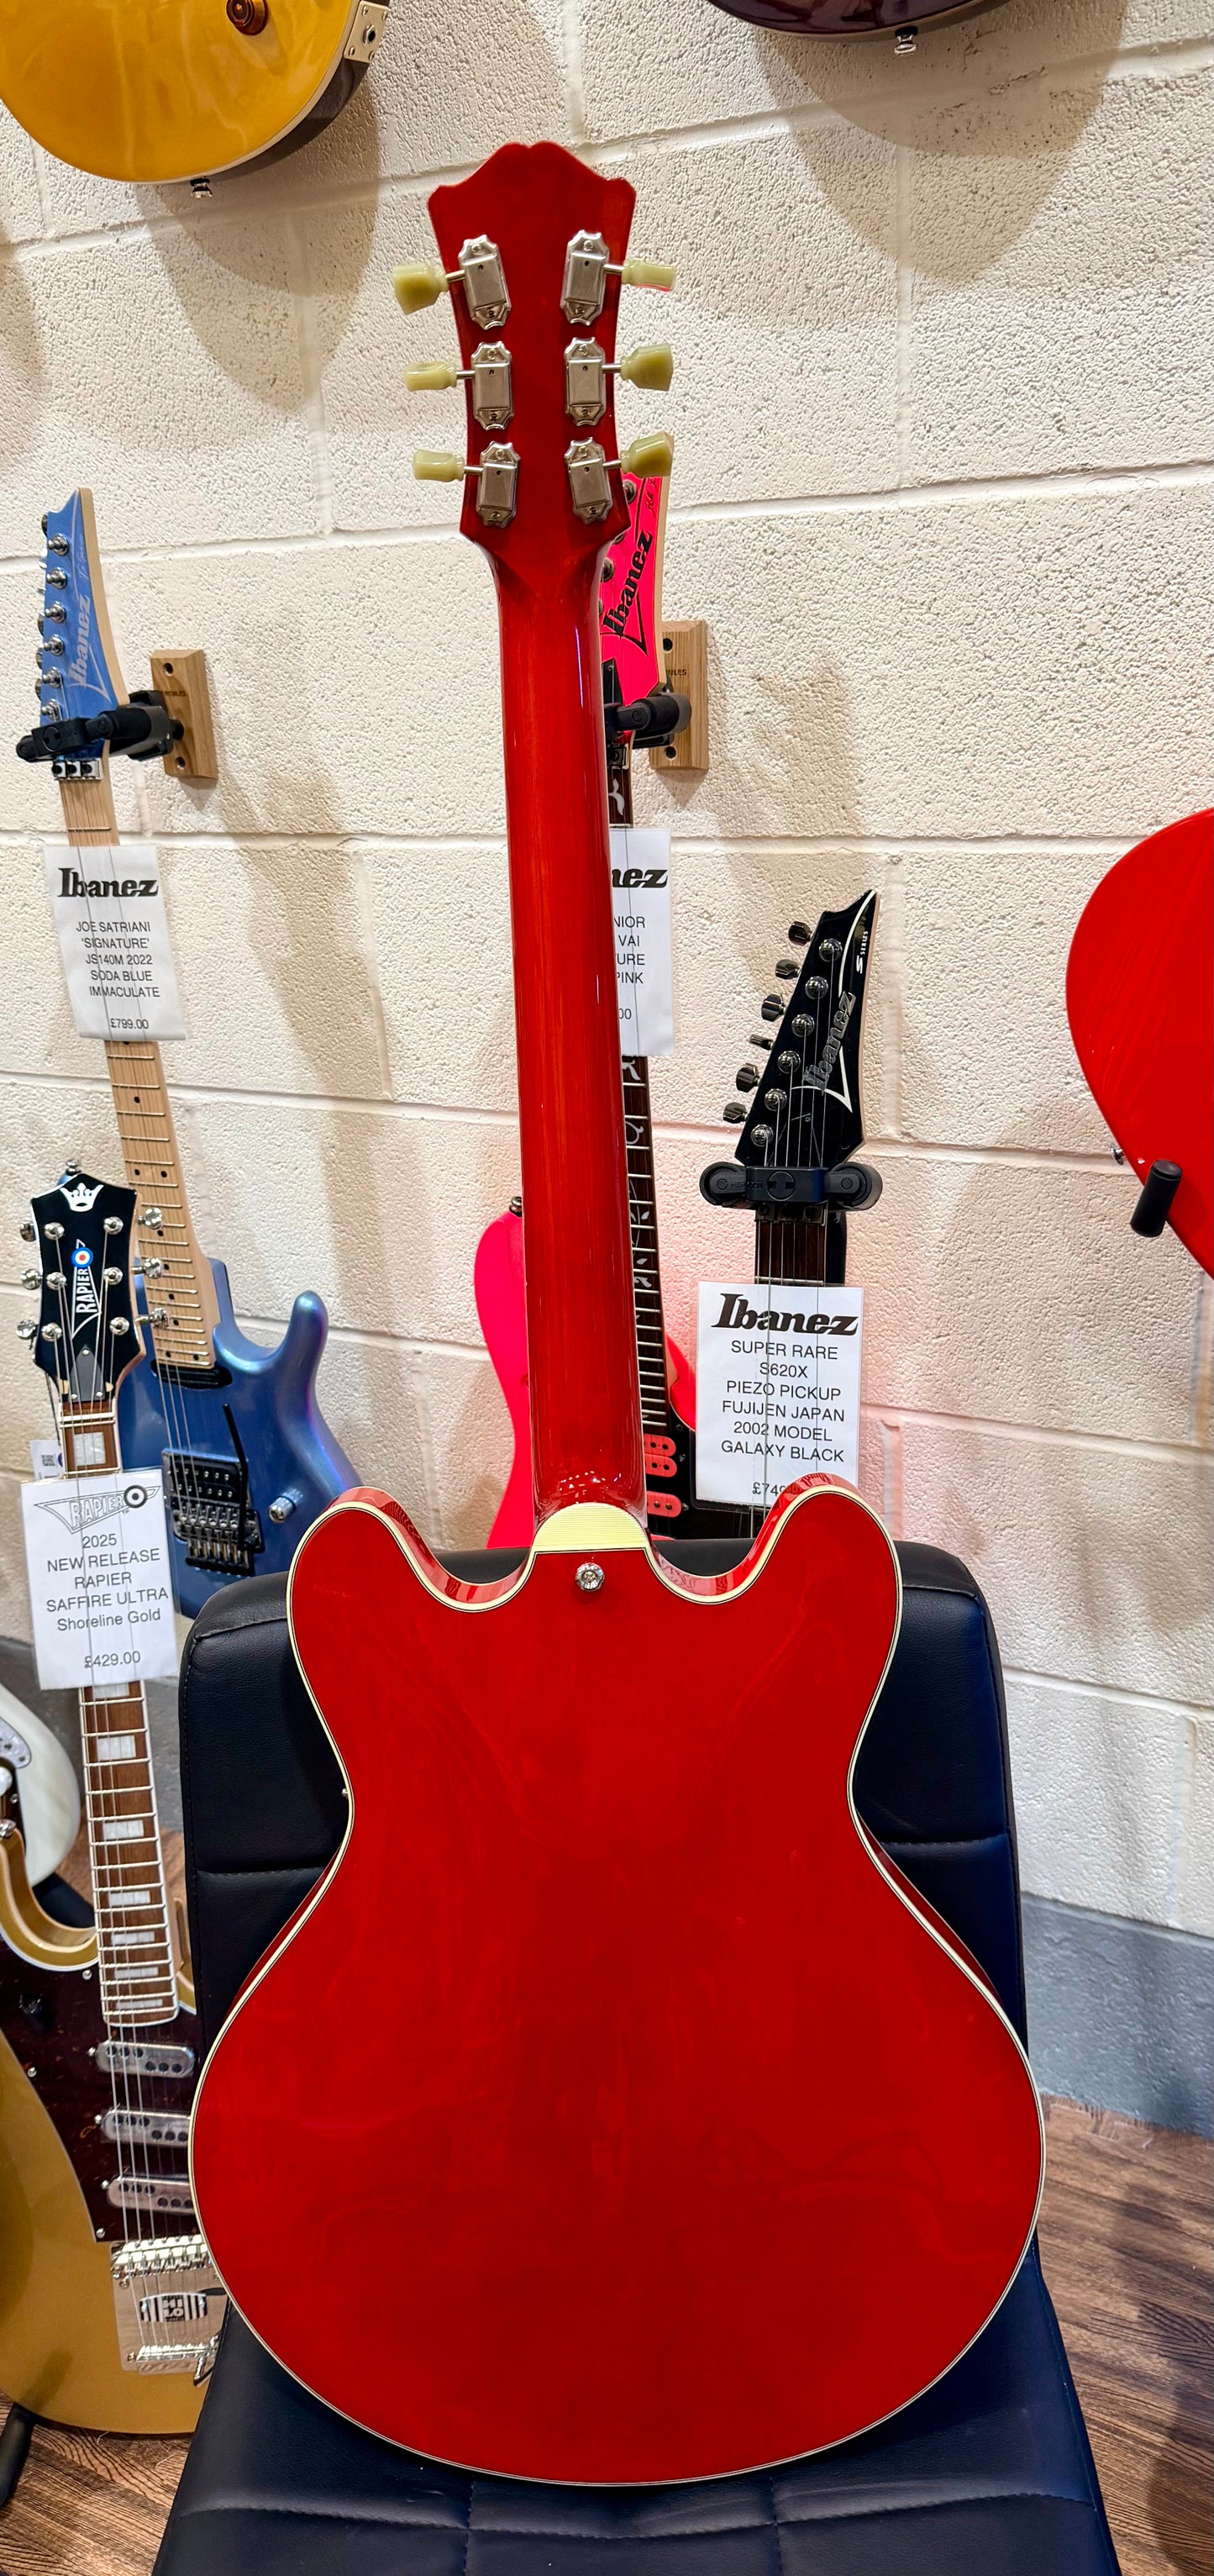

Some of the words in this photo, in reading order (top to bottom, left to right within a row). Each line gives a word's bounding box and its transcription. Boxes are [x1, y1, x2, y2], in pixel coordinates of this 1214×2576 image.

[603, 529, 653, 639] Ibanez
[67, 594, 92, 687] Ibanez
[57, 867, 159, 898] Ibanez
[612, 868, 668, 888] nez
[76, 921, 97, 932] JOE
[100, 921, 151, 932] SATRIANI
[614, 916, 645, 928] NIOR
[618, 935, 639, 946] VAI
[86, 955, 124, 966] JS140M
[127, 955, 153, 966] 2022
[616, 953, 645, 966] URE
[856, 955, 864, 974] S
[860, 930, 870, 956] SERIES
[91, 970, 120, 982] SODA
[123, 970, 153, 982] BLUE
[89, 986, 160, 998] IMMACULATE
[110, 1018, 150, 1030] £799.00
[802, 991, 856, 1096] Ibanez
[76, 1268, 98, 1313] RAPIER
[711, 1293, 859, 1336] Ibanez
[731, 1340, 787, 1356] SUPER
[791, 1344, 838, 1360] RARE
[759, 1362, 808, 1378] S620X
[727, 1381, 775, 1396] PIEZO
[780, 1384, 842, 1401] PICKUP
[722, 1400, 786, 1418] FUJIJEN
[791, 1406, 845, 1422] JAPAN
[733, 1421, 769, 1436] 2002
[774, 1425, 833, 1441] MODEL
[721, 1440, 786, 1457] GALAXY
[791, 1446, 845, 1462] BLACK
[752, 1482, 786, 1497] £74
[70, 1494, 126, 1529] RAPIER
[82, 1533, 118, 1549] 2025
[47, 1557, 83, 1572] NEW
[88, 1548, 160, 1567] RELEASE
[74, 1572, 132, 1589] RAPIER
[46, 1593, 112, 1612] SAFFIRE
[118, 1587, 169, 1605] ULTRA
[56, 1611, 124, 1631] Shoreline
[128, 1608, 161, 1624] Gold
[84, 1651, 141, 1669] £429.00
